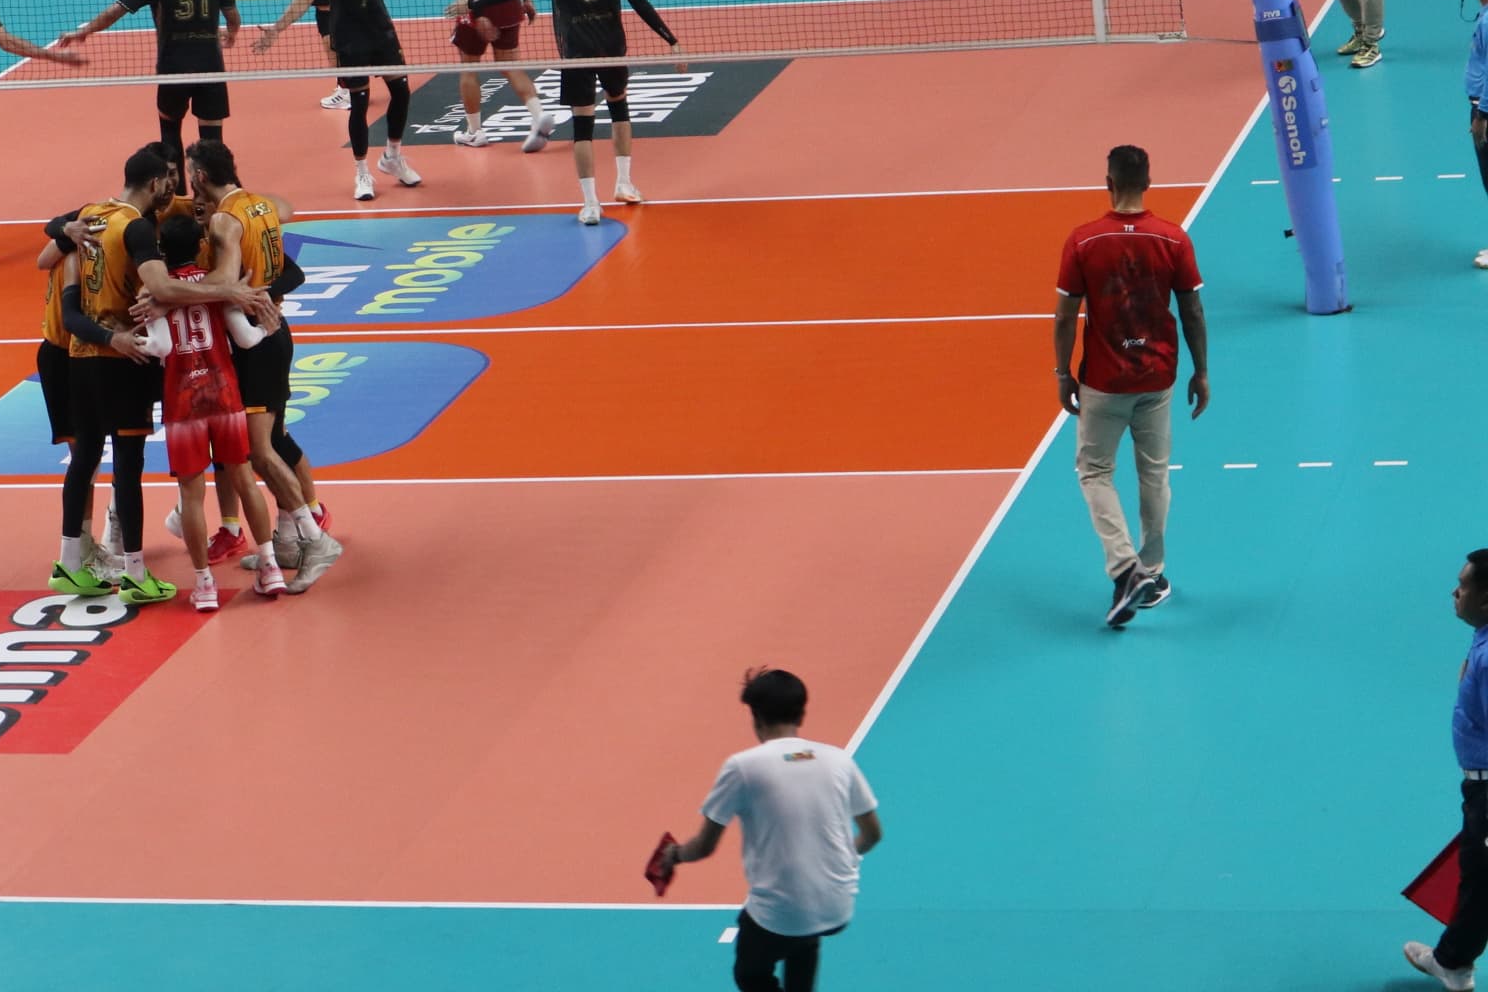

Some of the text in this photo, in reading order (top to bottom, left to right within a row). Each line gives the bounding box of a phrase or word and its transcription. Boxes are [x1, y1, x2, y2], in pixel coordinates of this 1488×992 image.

[1282, 96, 1307, 166] Senoh
[355, 223, 516, 315] mobile
[172, 303, 213, 355] 19
